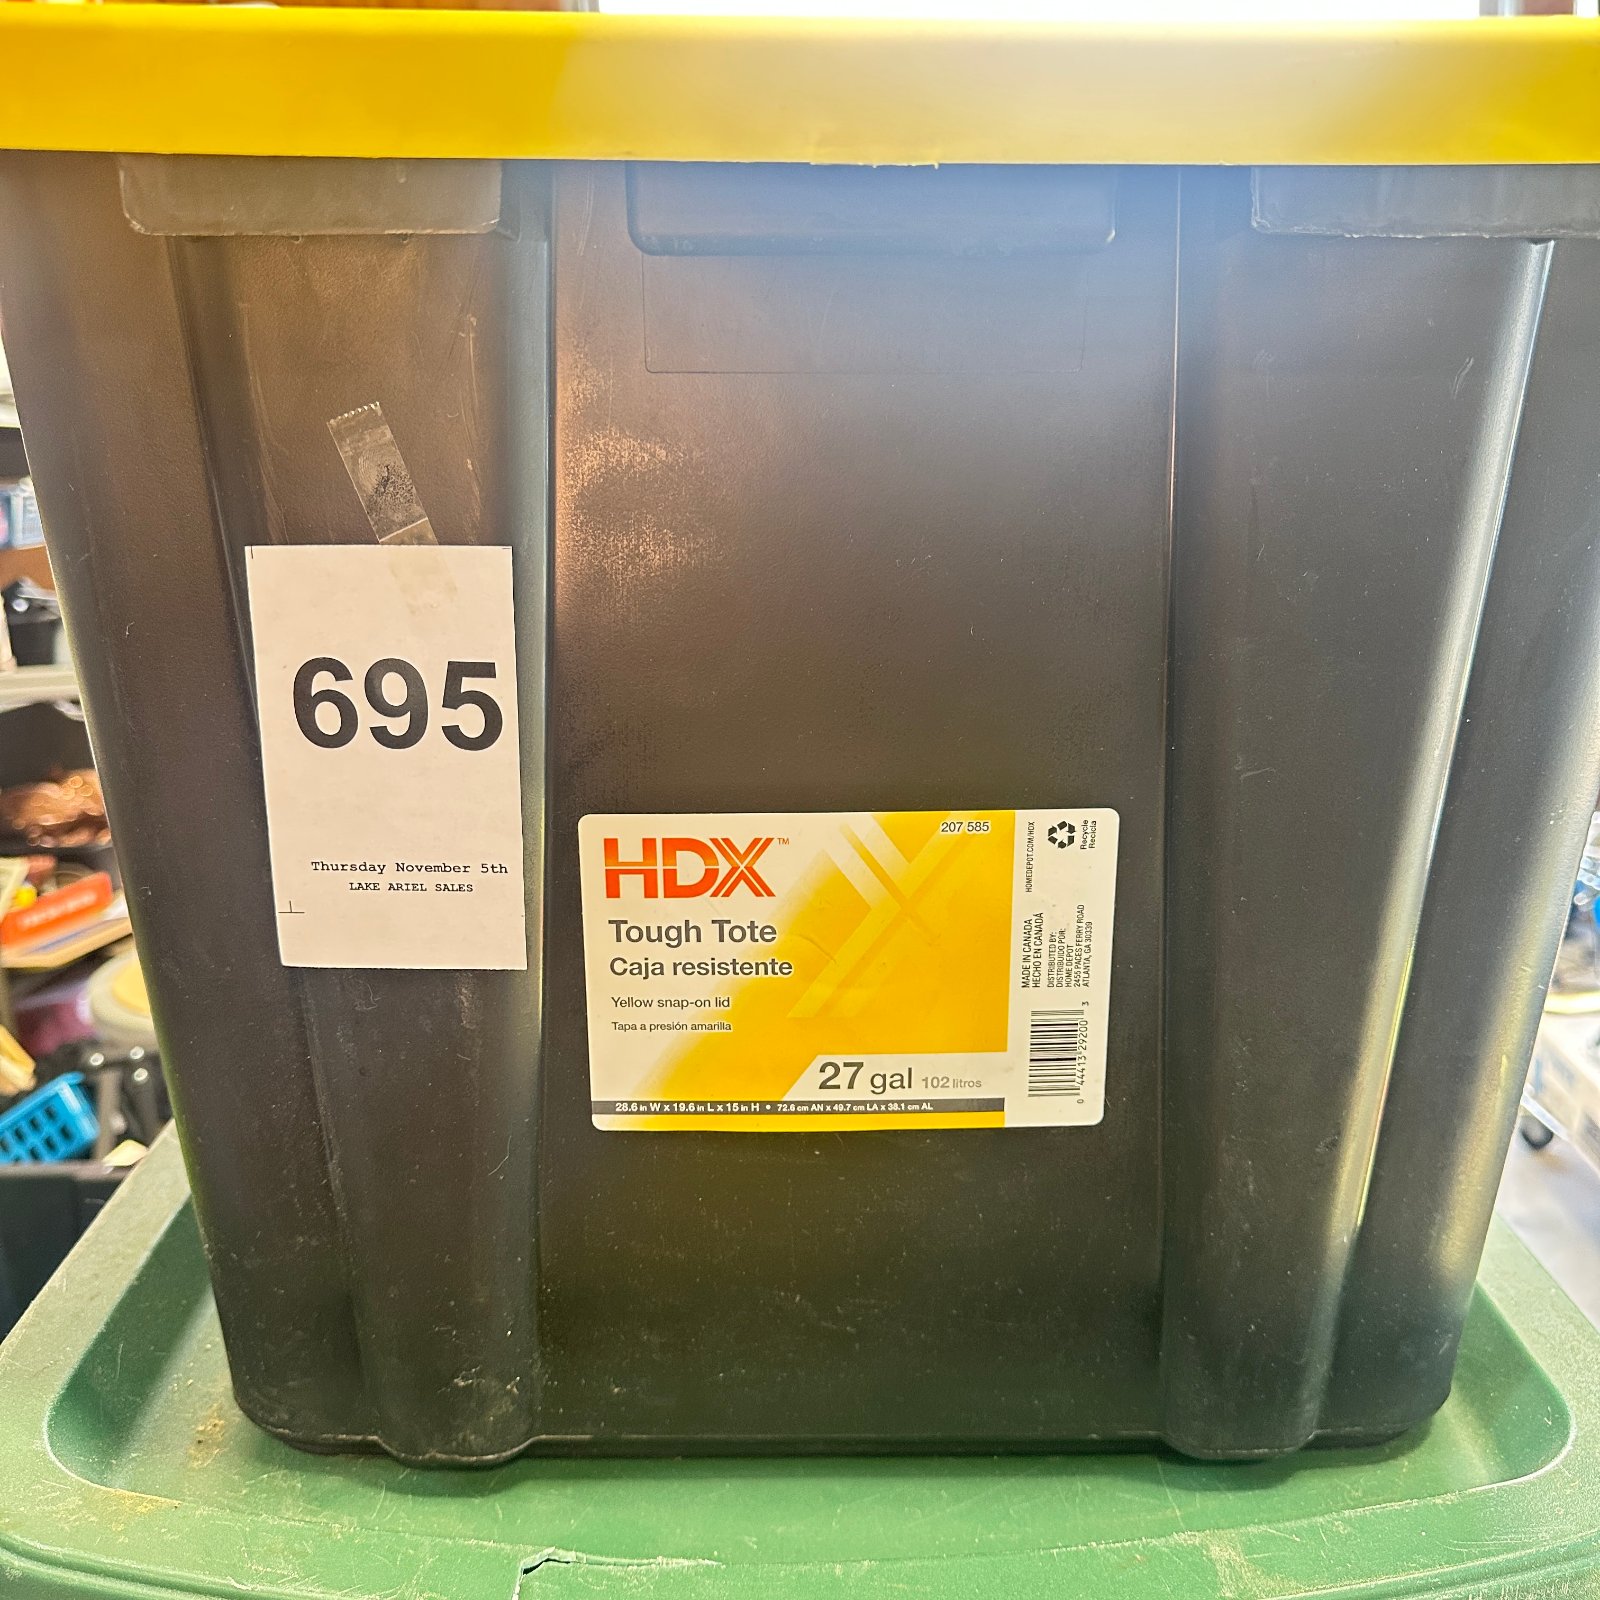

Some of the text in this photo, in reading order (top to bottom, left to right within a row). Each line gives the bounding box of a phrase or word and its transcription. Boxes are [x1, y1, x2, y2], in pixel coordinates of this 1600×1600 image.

[293, 657, 503, 751] 695
[941, 821, 990, 833] 207 585
[1080, 819, 1089, 850] Recycle
[1088, 820, 1097, 849] Recicla
[311, 861, 509, 874] Thursday November 5th
[603, 837, 776, 899] HDX
[1025, 821, 1035, 893] HOMEDEPOT.COM/HDX
[349, 882, 473, 892] LAKE ARIEL SALES
[608, 919, 777, 948] Tough Tote
[1073, 970, 1081, 987] 2455
[1077, 904, 1085, 924] ROAD
[609, 957, 793, 980] Caja resistente
[1021, 918, 1033, 988] MADE IN CANADA
[1033, 948, 1042, 959] EN
[1047, 931, 1057, 988] DISTRIBUTED BY:
[1056, 928, 1067, 988] DISTRIBUIDO POR:
[1065, 944, 1074, 987] HOME DEPOT
[1082, 921, 1093, 987] ATLANTA, GA 30339
[1032, 960, 1042, 988] HECHO
[611, 996, 730, 1010] Yellow snap-on lid
[611, 1021, 732, 1032] Tapa a presión amarilla
[1078, 1020, 1089, 1051] 29200
[818, 1061, 982, 1095] 27 gal 102 litros
[1076, 1055, 1087, 1086] 44413
[615, 1102, 638, 1112] 28.6
[640, 1104, 647, 1112] in
[650, 1103, 661, 1112] W
[673, 1102, 695, 1112] 19.6
[697, 1104, 705, 1112] in
[707, 1102, 714, 1112] L
[726, 1102, 739, 1112] 15
[741, 1104, 749, 1112] in
[751, 1103, 760, 1112] H
[777, 1103, 796, 1112] 72.6
[811, 1103, 824, 1112] AN
[833, 1103, 851, 1112] 49.7
[866, 1103, 879, 1111] LA
[888, 1103, 905, 1111] 38.1
[921, 1102, 934, 1111] AL
